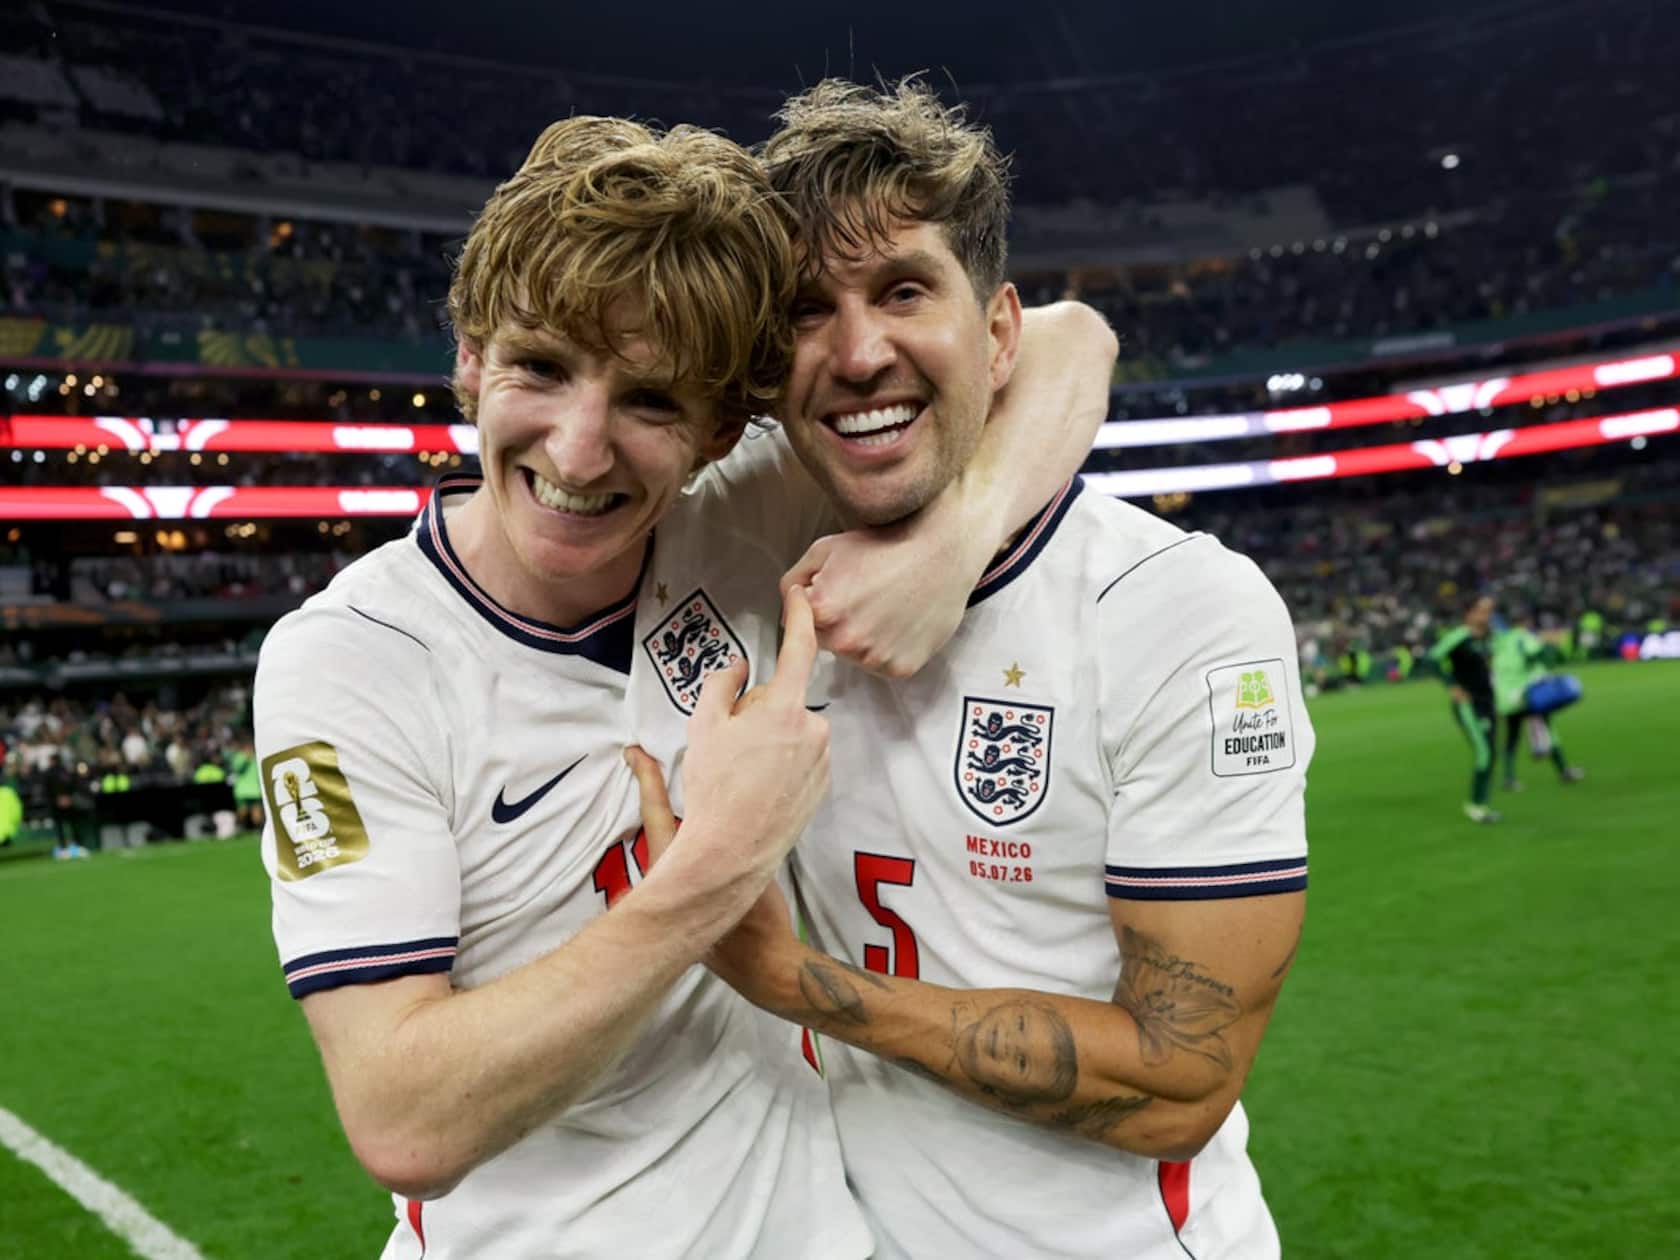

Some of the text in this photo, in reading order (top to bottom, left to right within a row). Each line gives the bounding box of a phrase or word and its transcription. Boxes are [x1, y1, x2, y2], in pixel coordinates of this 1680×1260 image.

[1224, 731, 1286, 755] EDUCATION
[1246, 755, 1270, 767] FIFA
[966, 834, 1031, 859] MEXICO
[969, 860, 1033, 882] 05.07.26
[854, 850, 919, 980] 5
